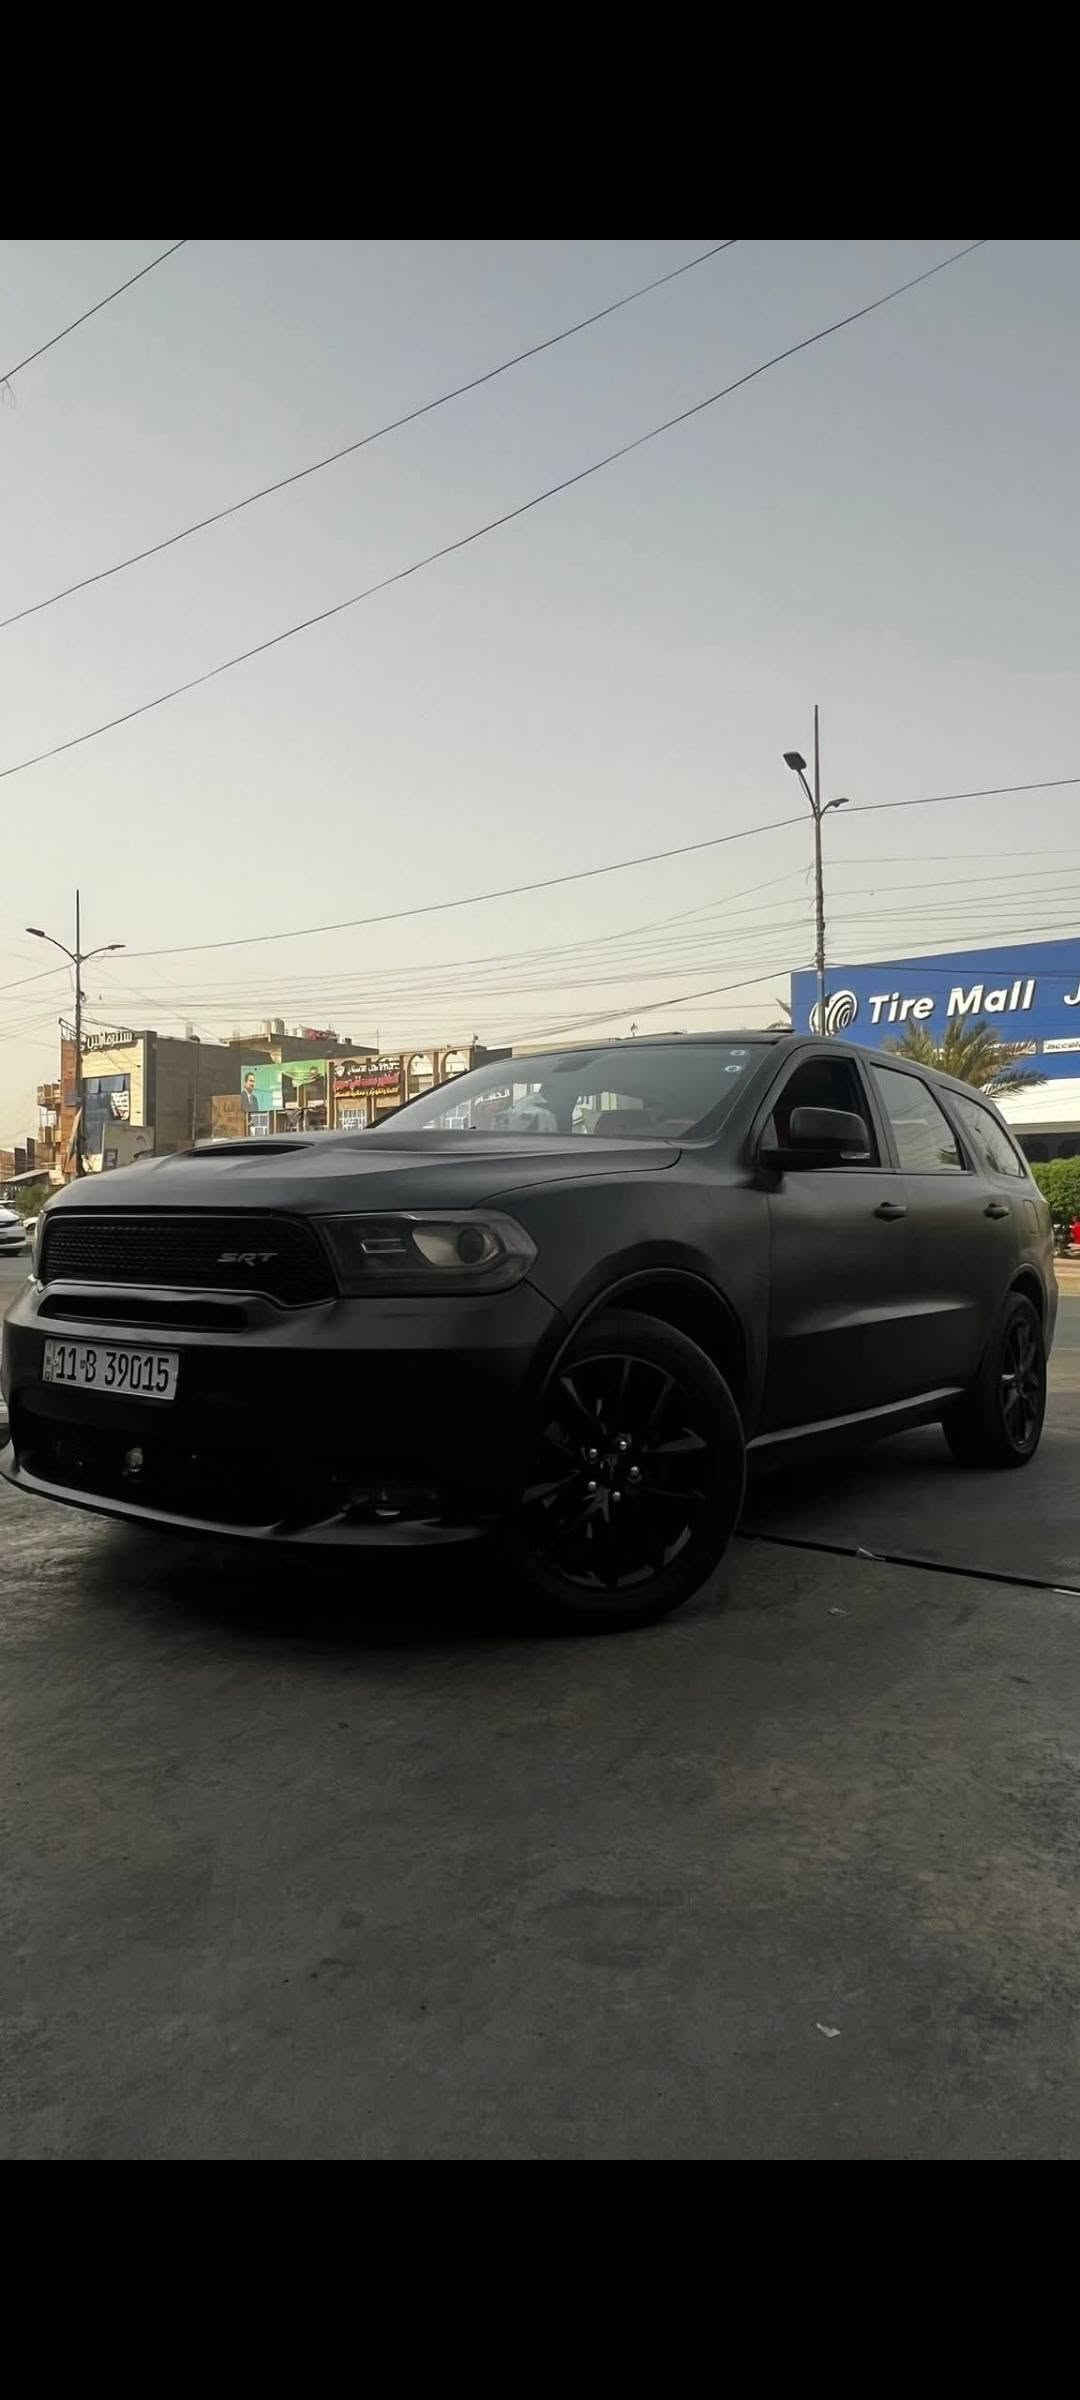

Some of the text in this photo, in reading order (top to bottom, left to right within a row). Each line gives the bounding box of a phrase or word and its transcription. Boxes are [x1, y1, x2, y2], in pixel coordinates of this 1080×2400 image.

[868, 991, 935, 1024] Tire
[946, 979, 1036, 1017] Mall
[215, 1252, 278, 1267] SRT
[104, 1351, 169, 1392] 39015
